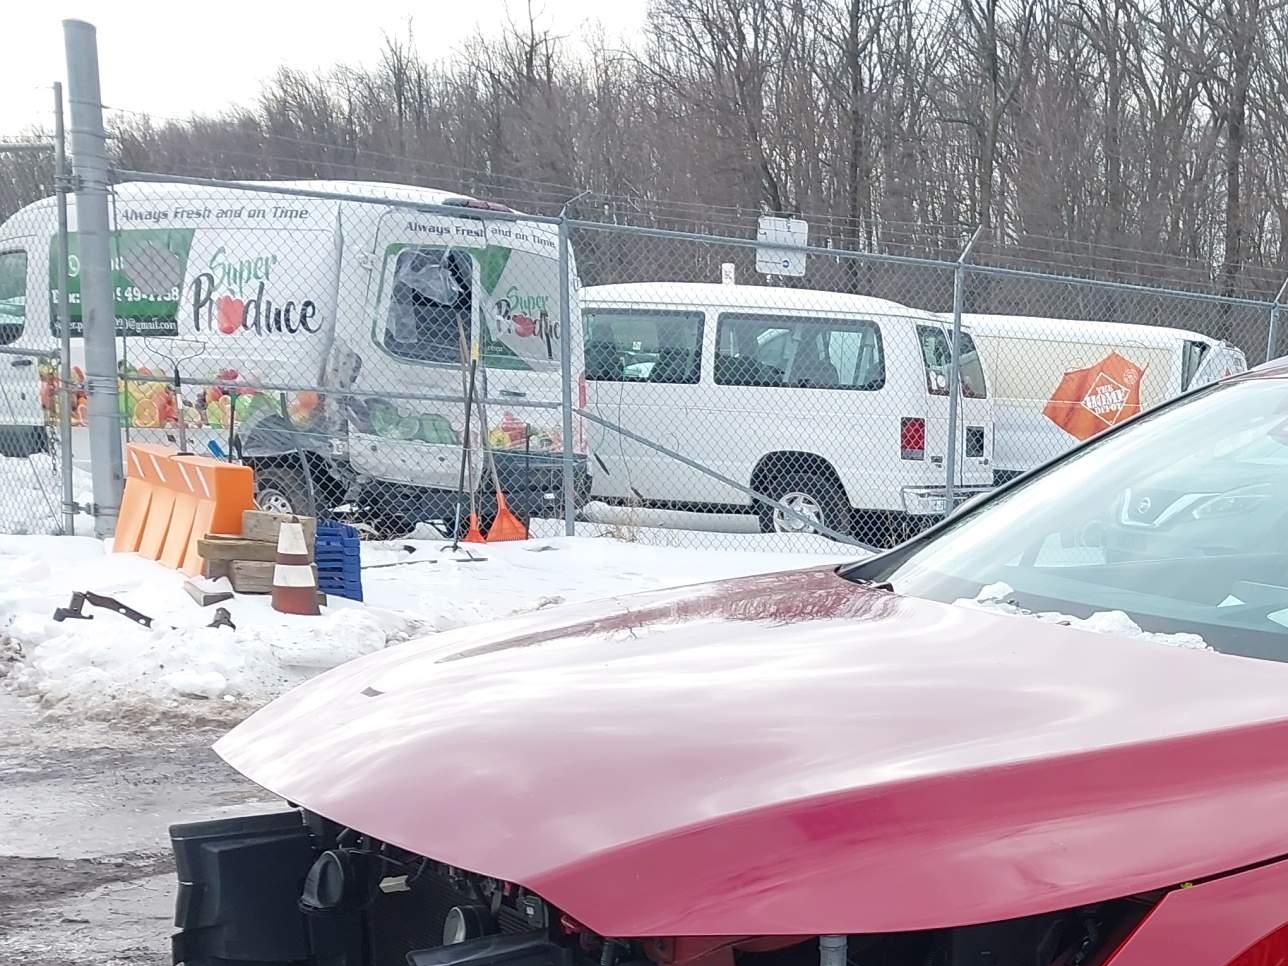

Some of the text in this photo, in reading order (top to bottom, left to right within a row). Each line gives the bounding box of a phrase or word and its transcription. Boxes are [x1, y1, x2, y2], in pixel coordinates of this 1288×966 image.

[121, 206, 308, 223] Always Fresh and on Time
[405, 221, 450, 236] Always
[491, 227, 511, 238] and
[515, 232, 529, 242] on
[532, 234, 556, 248] Time
[209, 245, 278, 293] Super
[506, 285, 549, 316] Super
[1095, 383, 1114, 394] THE
[1084, 389, 1125, 408] HOME
[1094, 403, 1123, 415] DEPOT
